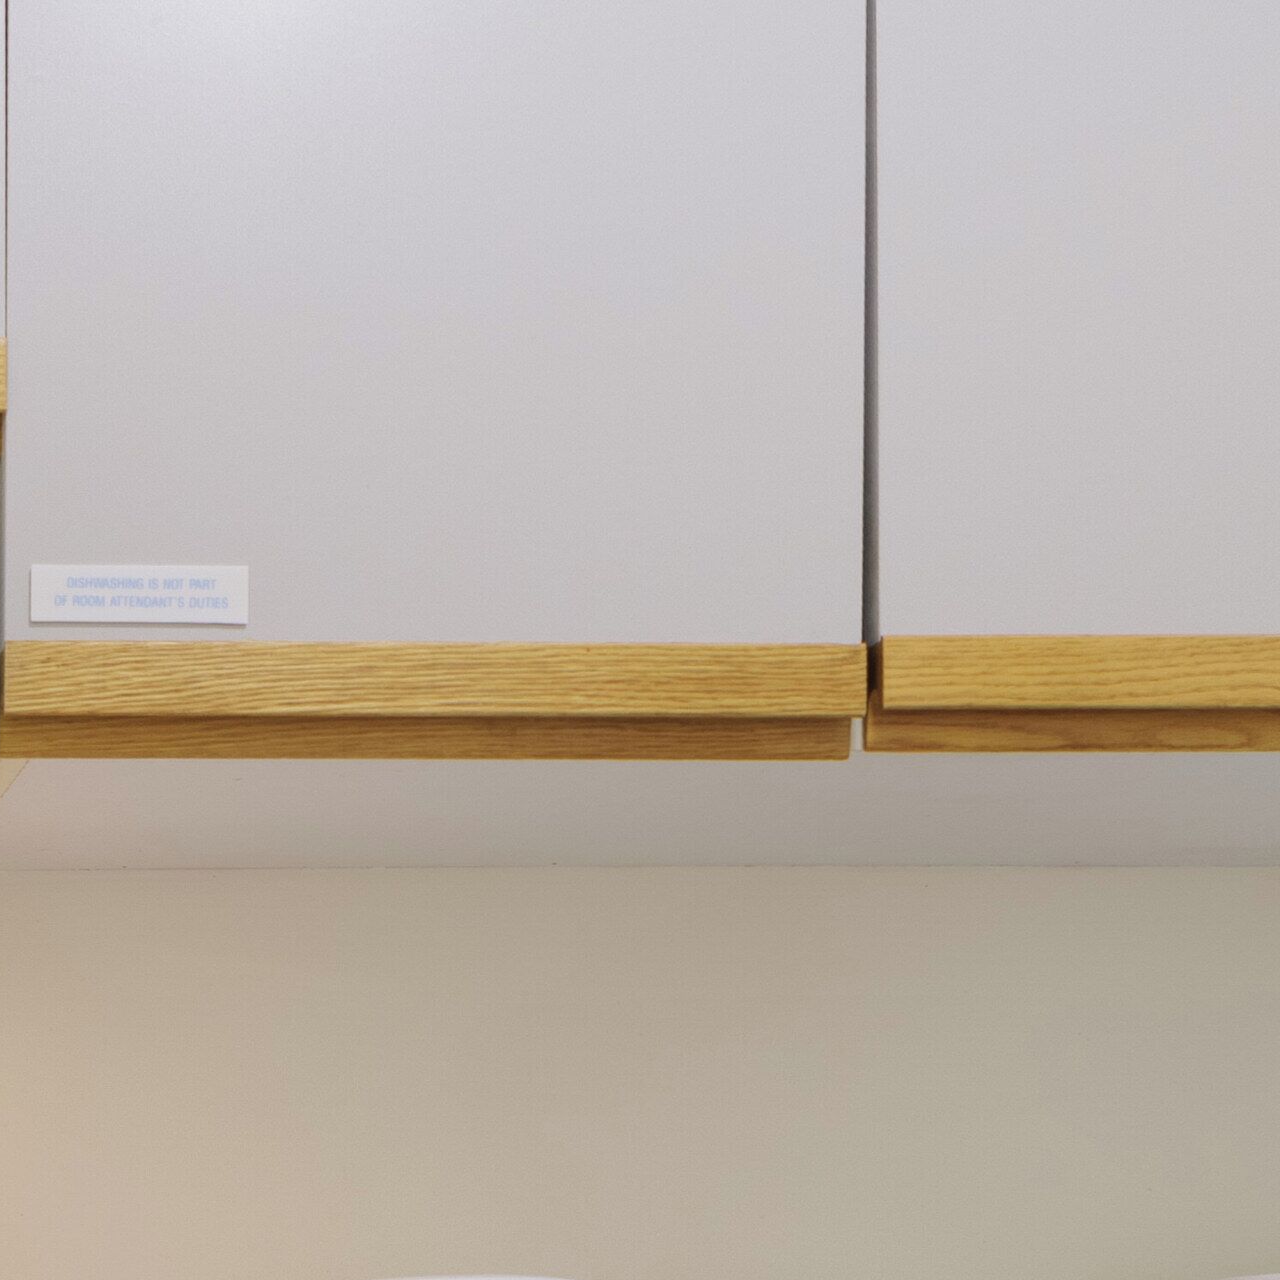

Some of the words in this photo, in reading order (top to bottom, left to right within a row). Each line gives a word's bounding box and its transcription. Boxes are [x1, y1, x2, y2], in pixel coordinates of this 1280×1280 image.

[67, 576, 144, 590] DISHWASHING
[148, 577, 159, 590] IS
[163, 577, 183, 590] NOT
[189, 577, 217, 590] PART
[54, 594, 67, 607] OF
[73, 594, 105, 607] ROOM
[111, 595, 185, 609] ATTENDANT'S
[189, 596, 229, 609] DUTIES
